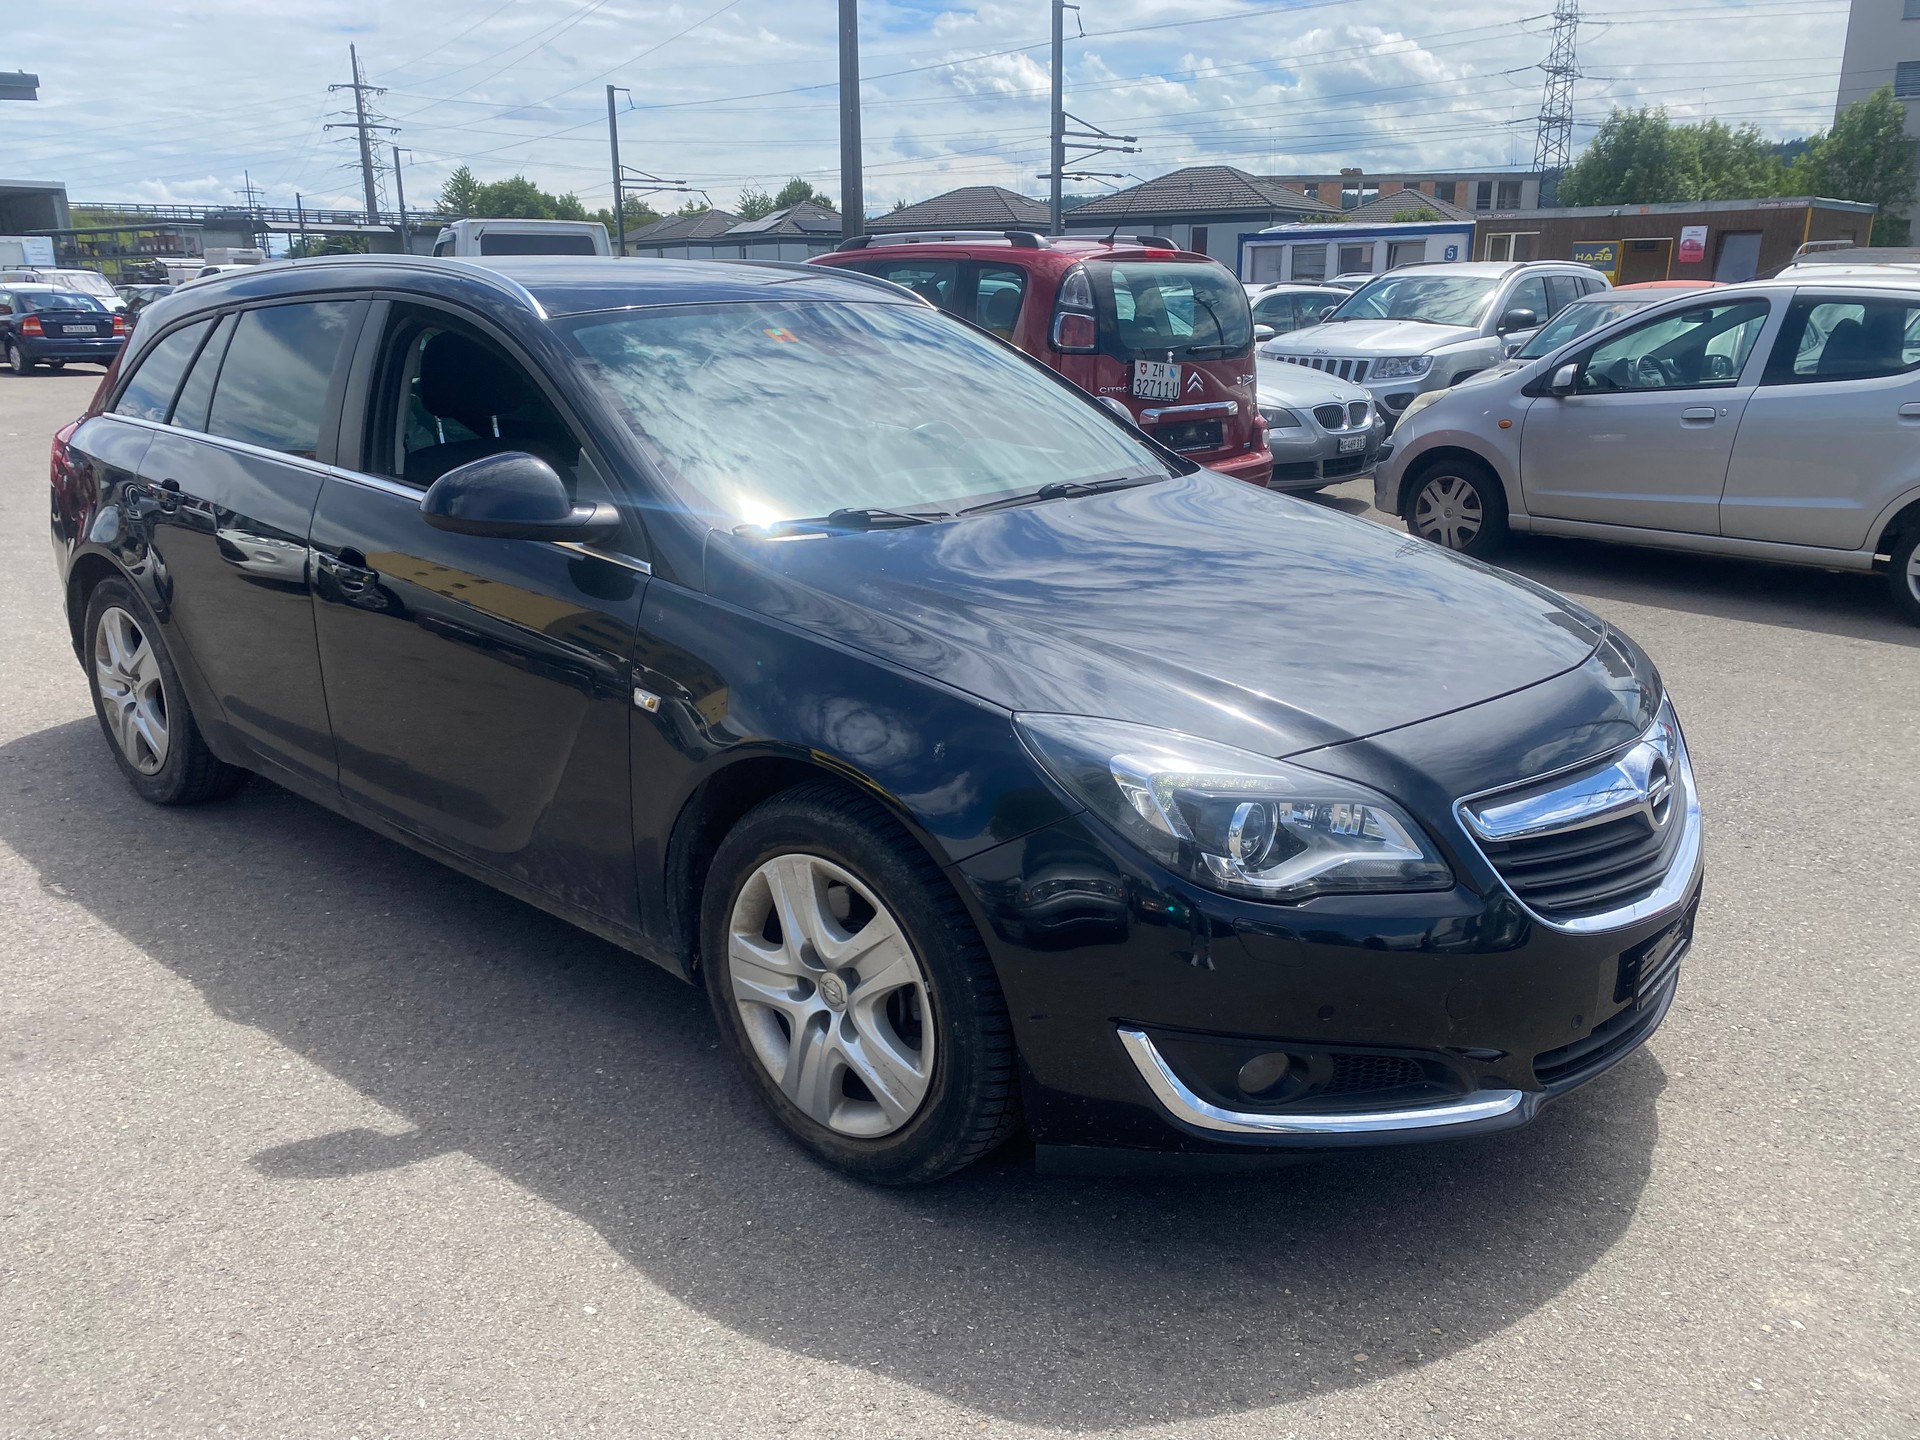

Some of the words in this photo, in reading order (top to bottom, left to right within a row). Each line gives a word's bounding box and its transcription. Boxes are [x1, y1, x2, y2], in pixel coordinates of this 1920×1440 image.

[1447, 247, 1454, 259] 5
[1575, 253, 1613, 261] HARB
[1152, 364, 1165, 378] ZH
